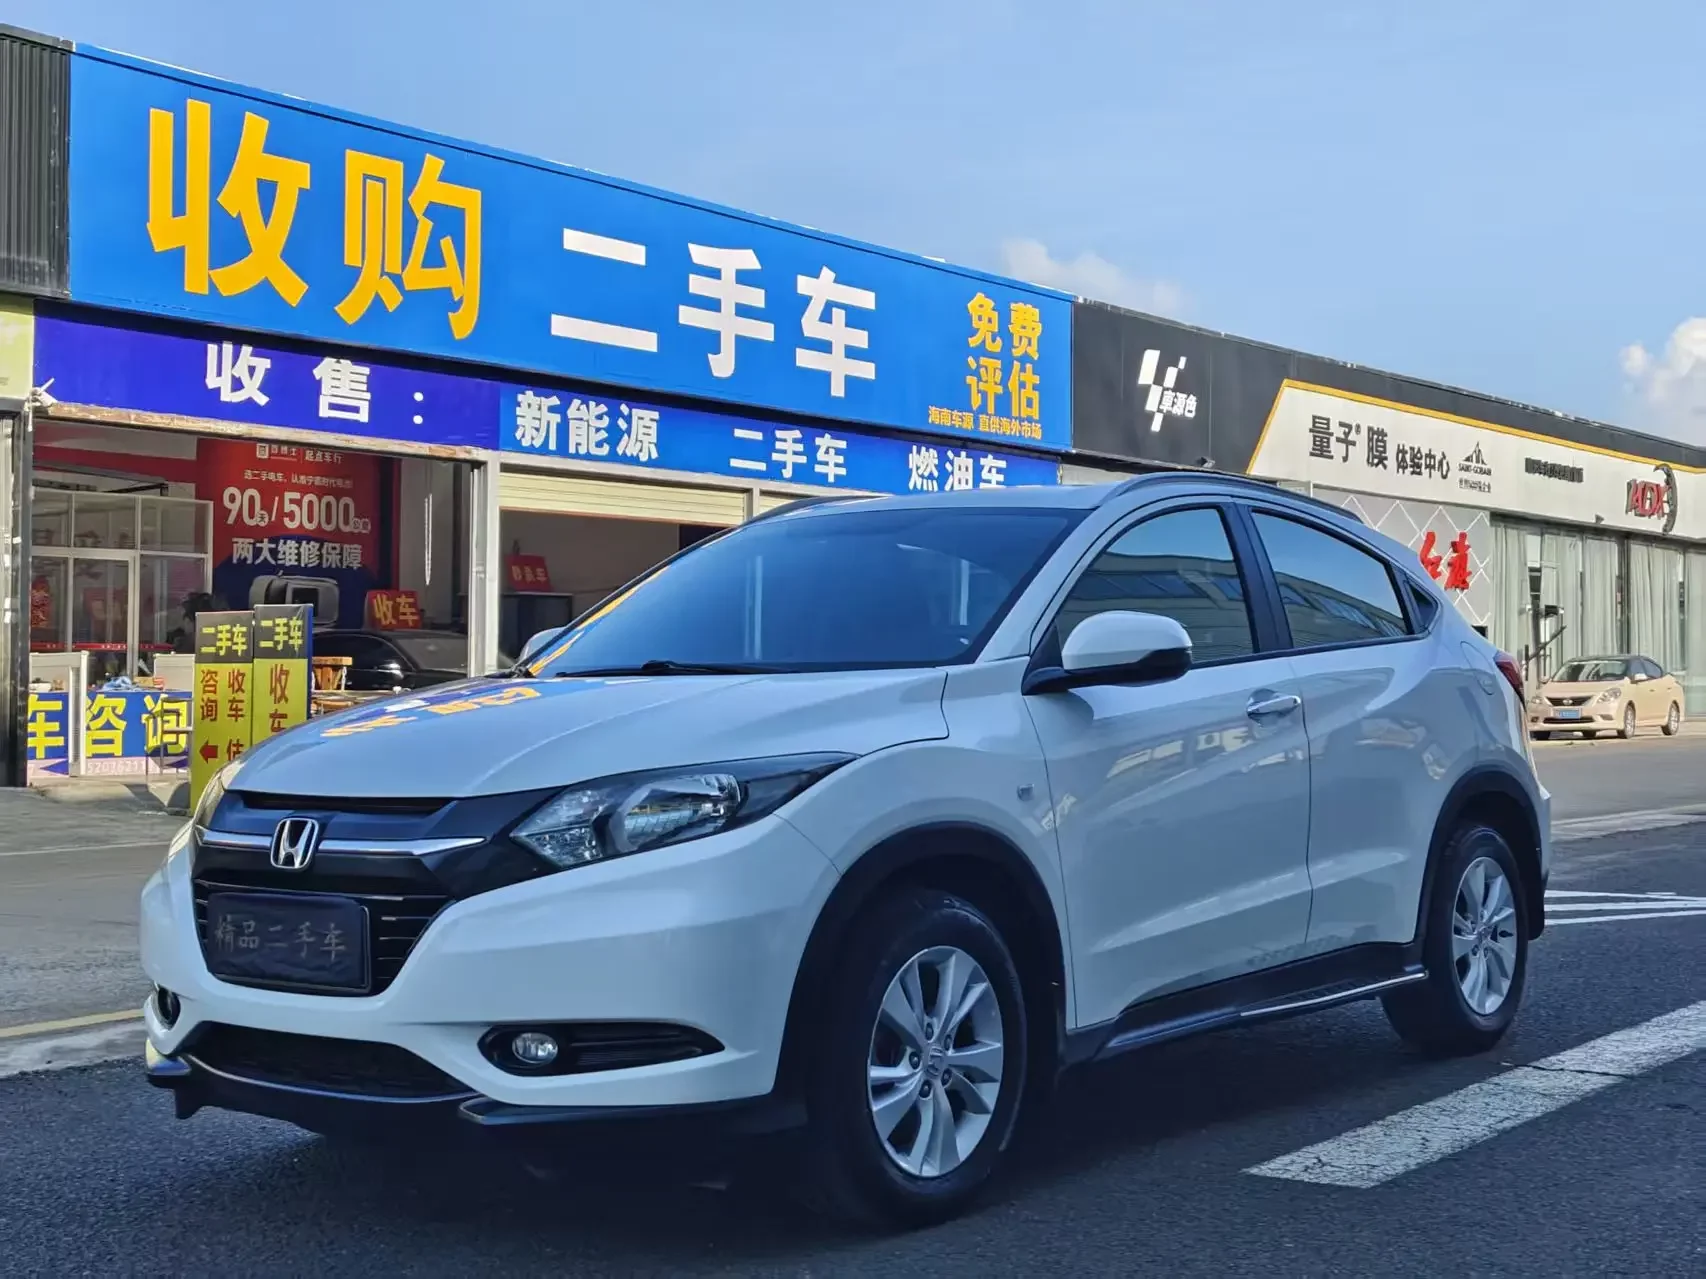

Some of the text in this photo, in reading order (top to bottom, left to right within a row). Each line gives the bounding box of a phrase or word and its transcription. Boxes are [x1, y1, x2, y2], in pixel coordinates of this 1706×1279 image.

[147, 98, 876, 398] 收购 二手车
[967, 292, 1042, 360] 免费
[966, 356, 1040, 420] 评估
[515, 389, 1007, 492] 新能源 二手车 燃油车
[929, 405, 1042, 440] 海南车源 直供海外市场
[1396, 444, 1451, 480] 体验中心
[232, 537, 362, 570] 两大维修保障
[371, 593, 419, 627] 收车
[201, 624, 248, 657] 二手车
[259, 617, 304, 652] 二手车
[200, 669, 219, 722] 咨询
[215, 914, 346, 962] 精品二手车
